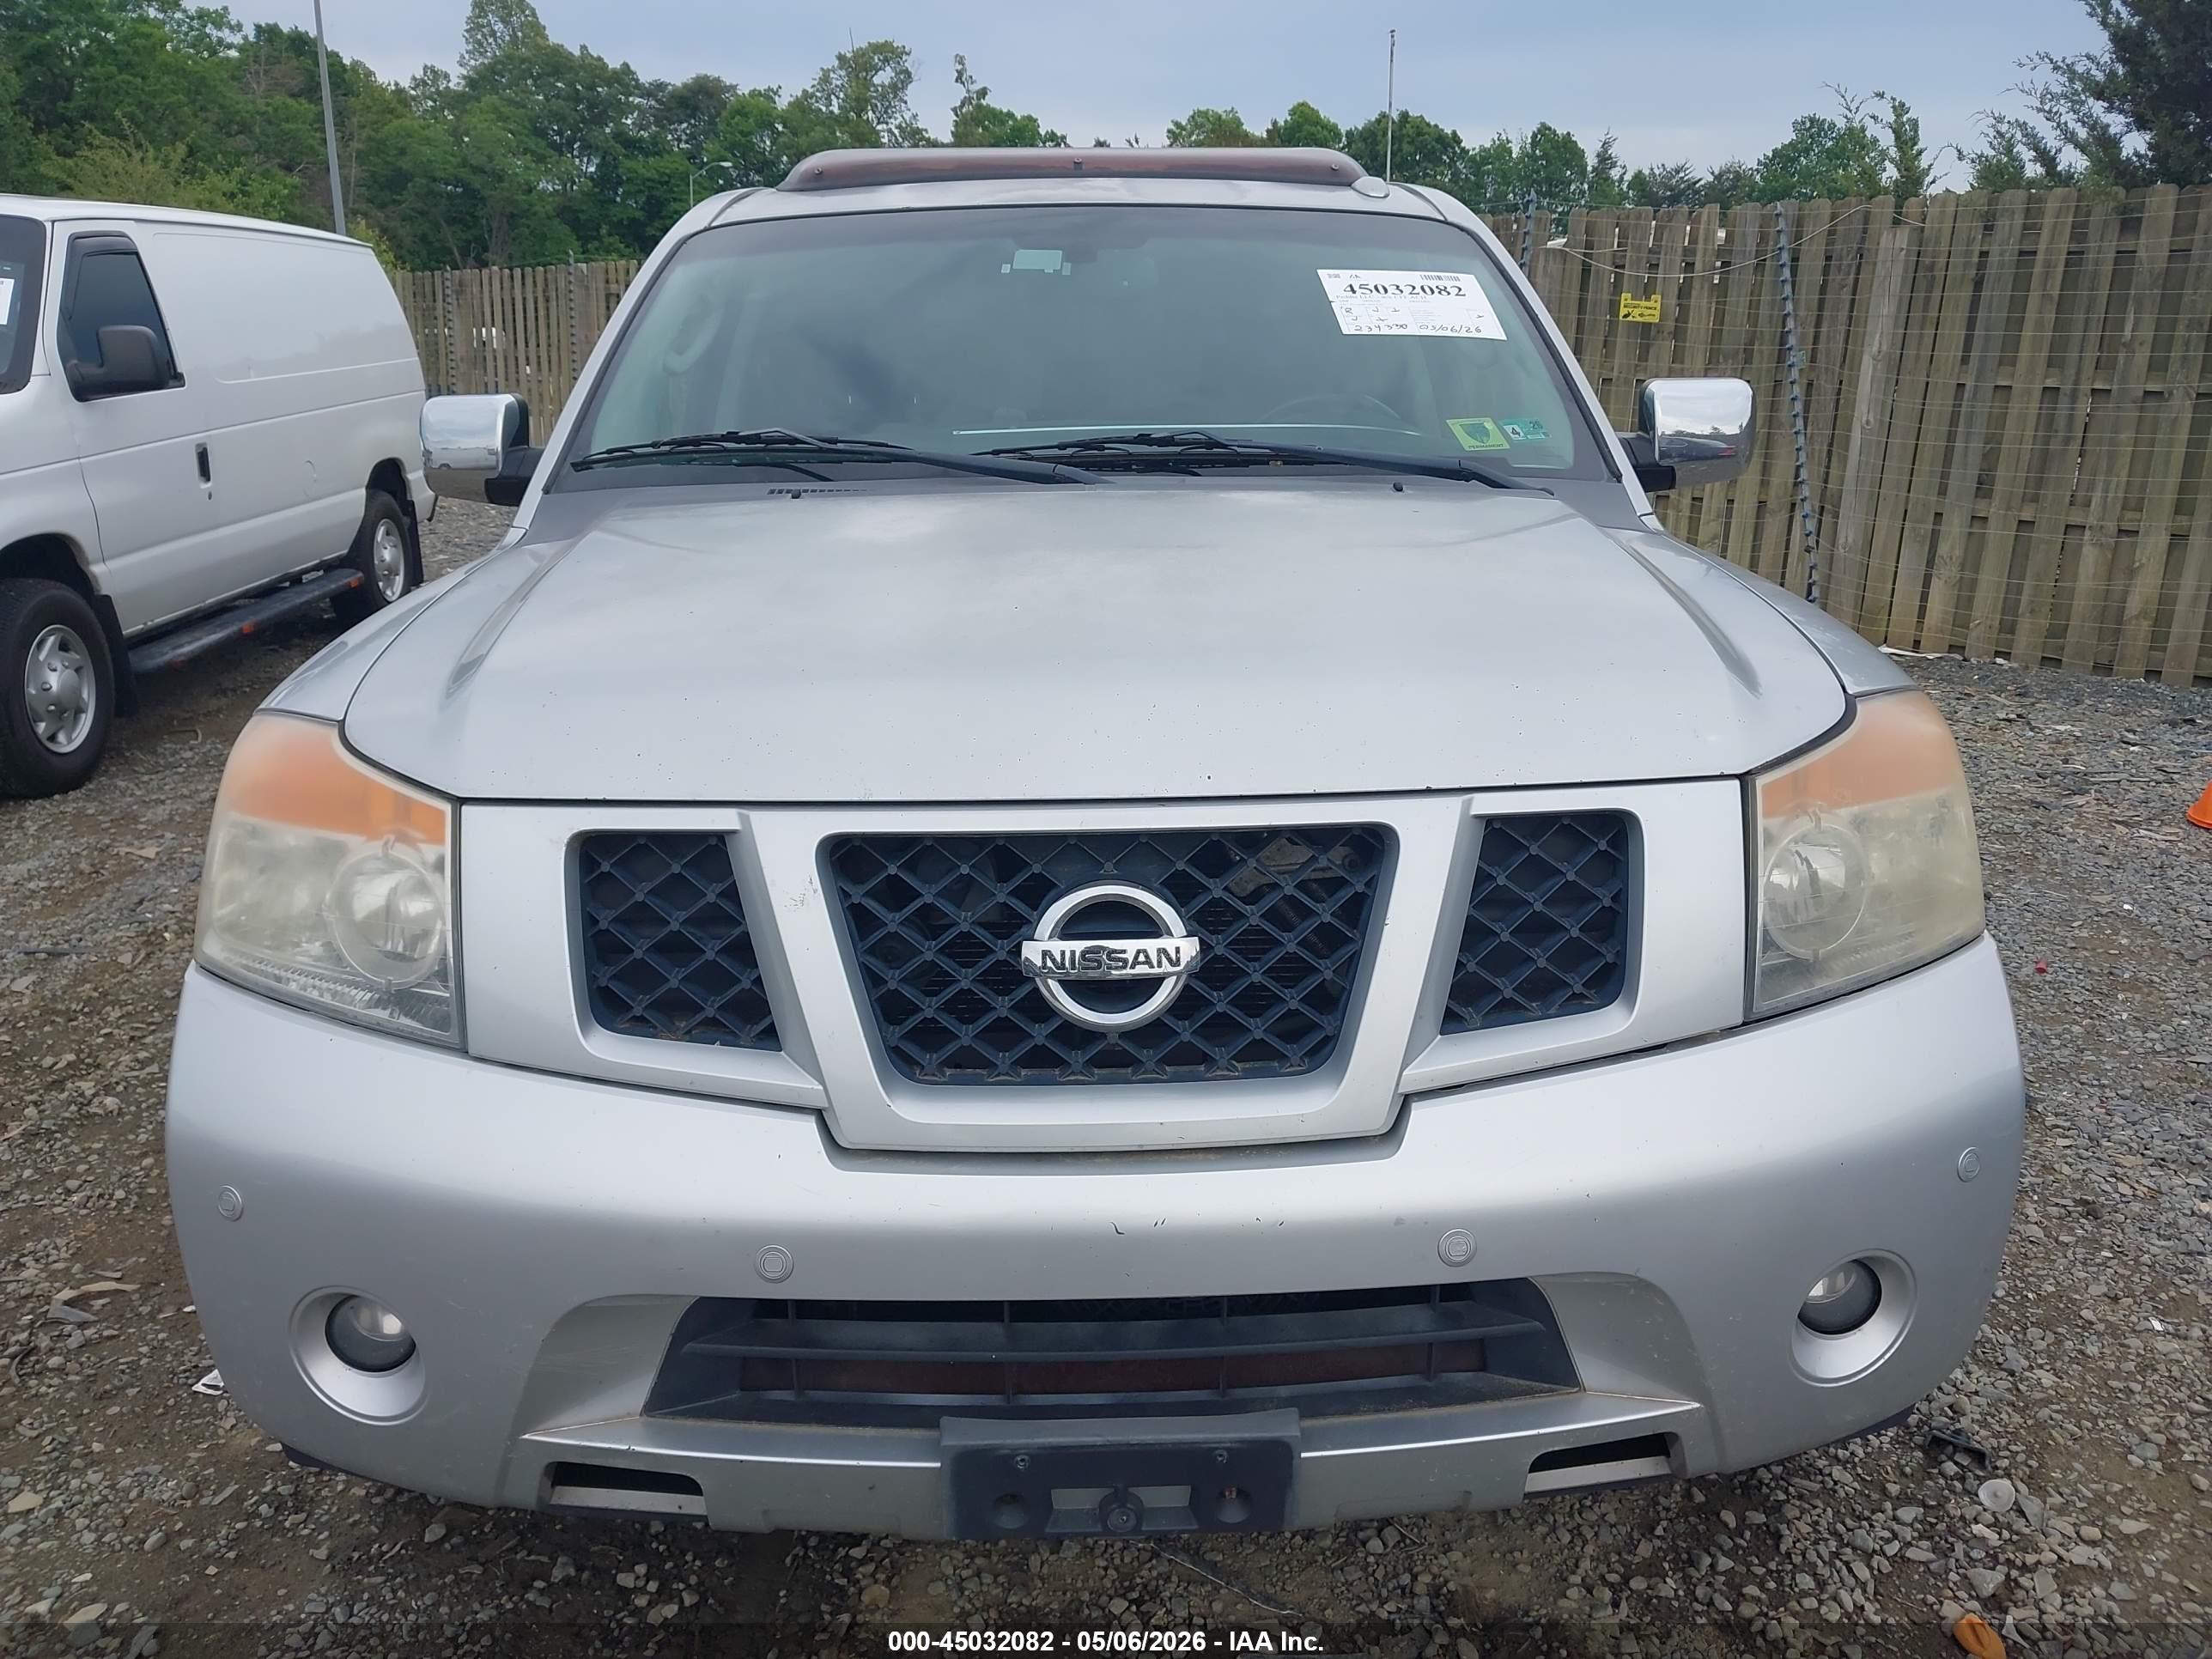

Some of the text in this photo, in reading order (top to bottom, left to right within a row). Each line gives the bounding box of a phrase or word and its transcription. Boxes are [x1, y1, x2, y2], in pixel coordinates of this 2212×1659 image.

[1343, 283, 1467, 297] 45032082
[1511, 427, 1521, 437] 4
[1041, 946, 1182, 972] NISSAN
